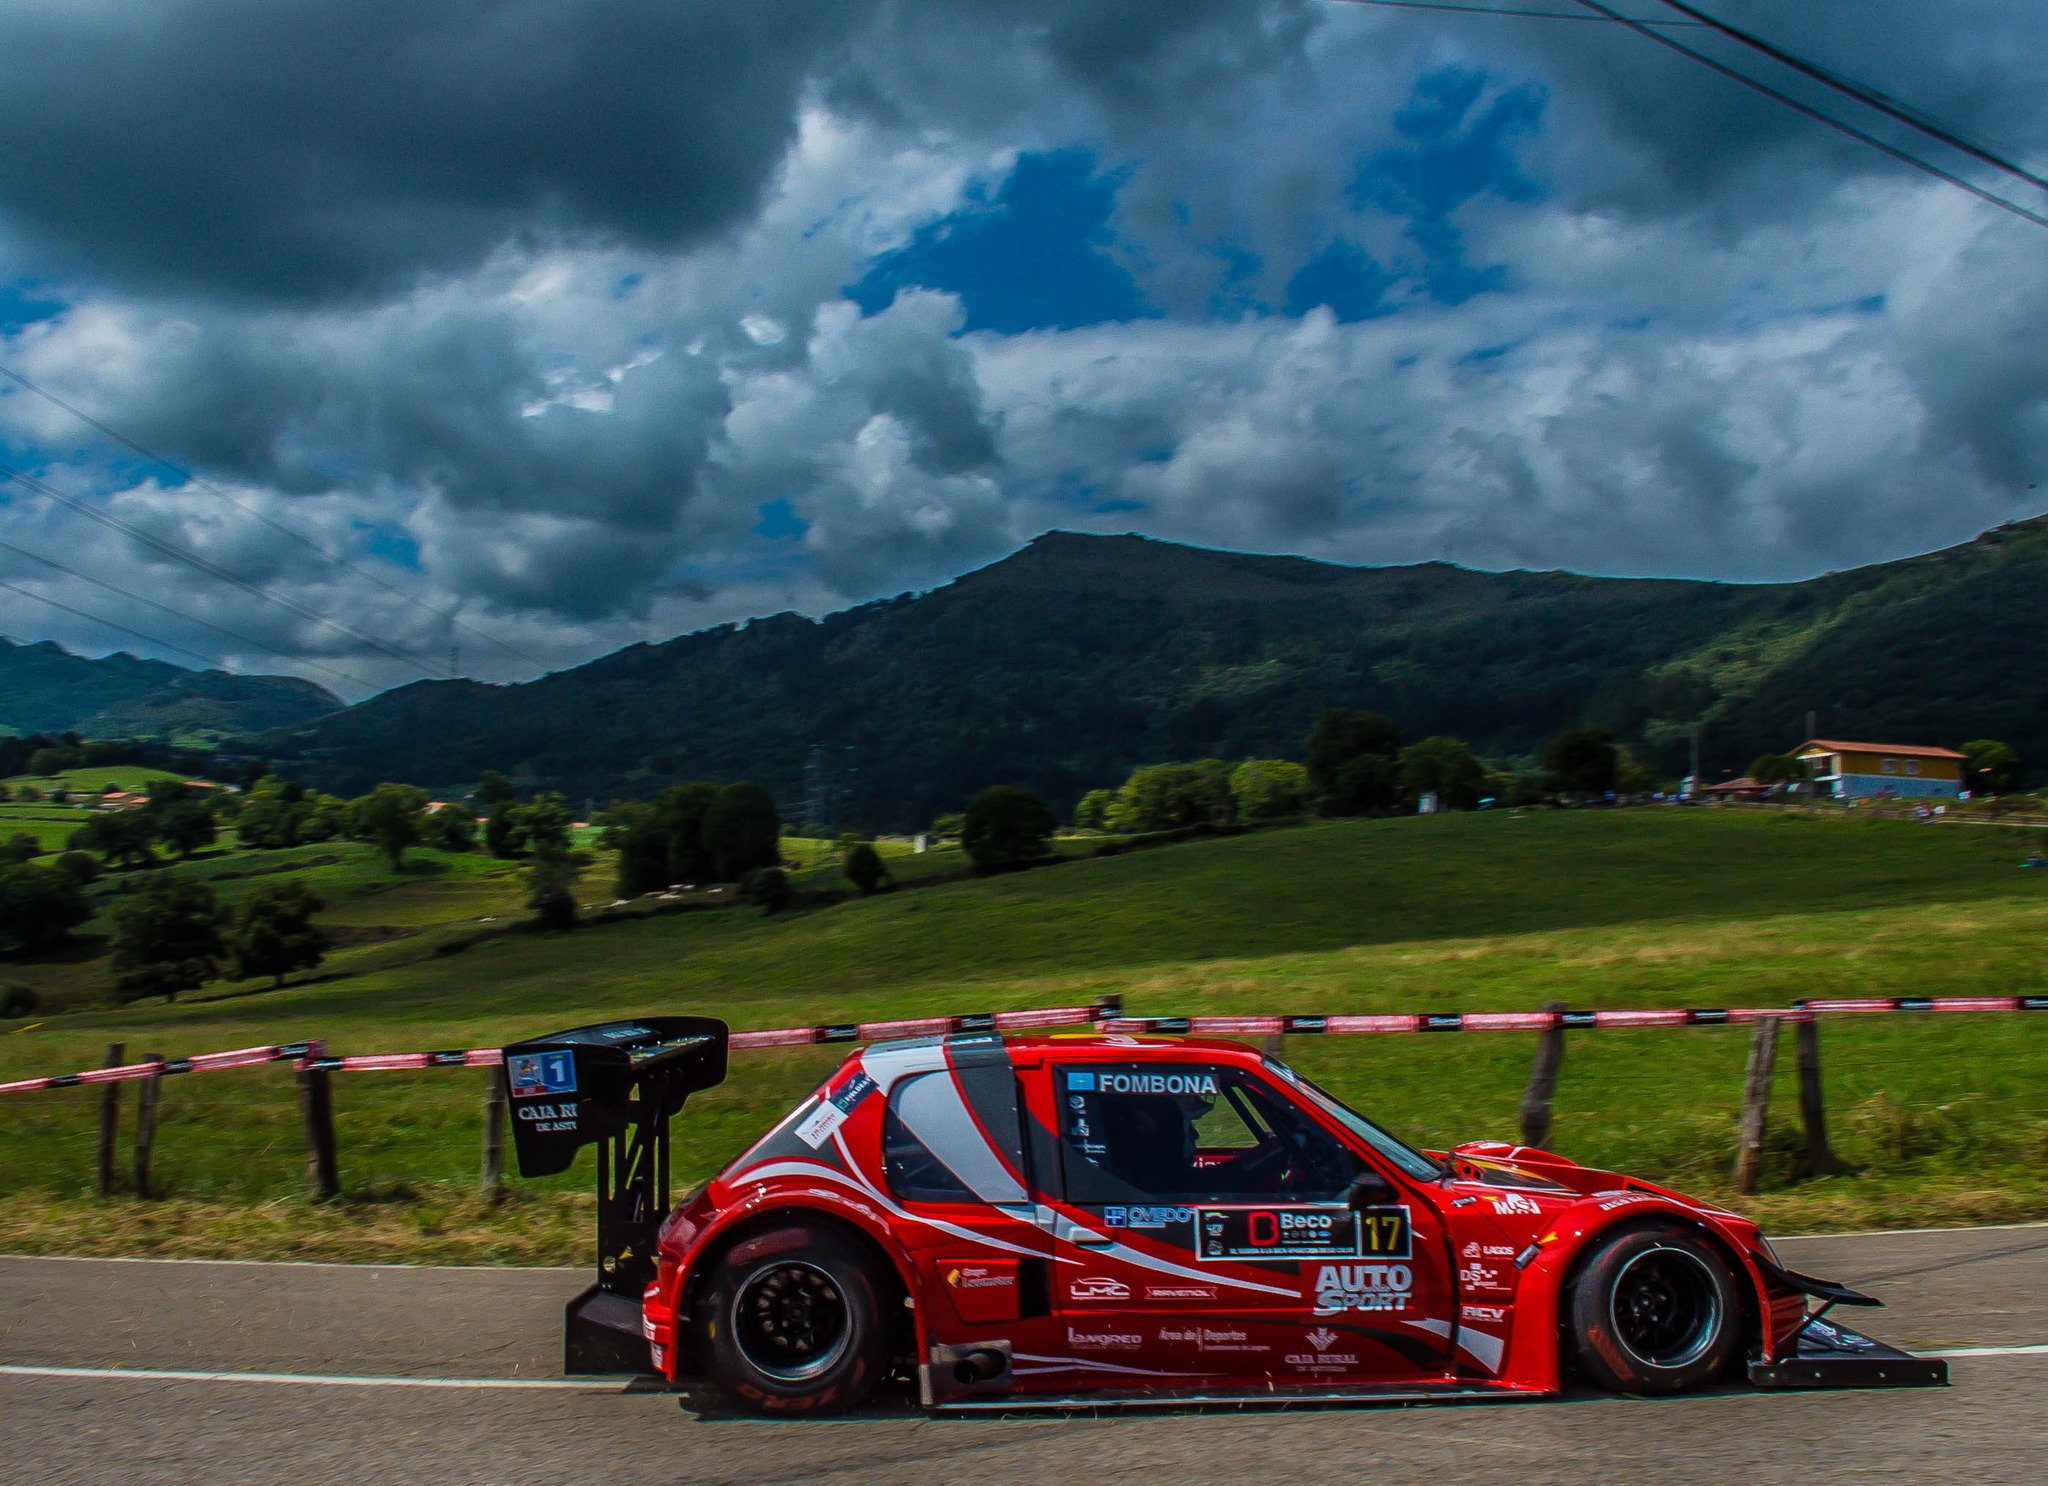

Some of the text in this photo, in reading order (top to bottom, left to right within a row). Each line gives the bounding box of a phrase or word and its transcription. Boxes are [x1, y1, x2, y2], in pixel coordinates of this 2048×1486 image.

[550, 1060, 565, 1082] 1
[1099, 1074, 1218, 1094] FOMBONA
[1279, 1212, 1333, 1230] Beco
[1365, 1216, 1400, 1251] 17
[1314, 1264, 1413, 1292] AUTO
[1070, 1284, 1131, 1297] LMC
[1312, 1289, 1413, 1316] SPORT
